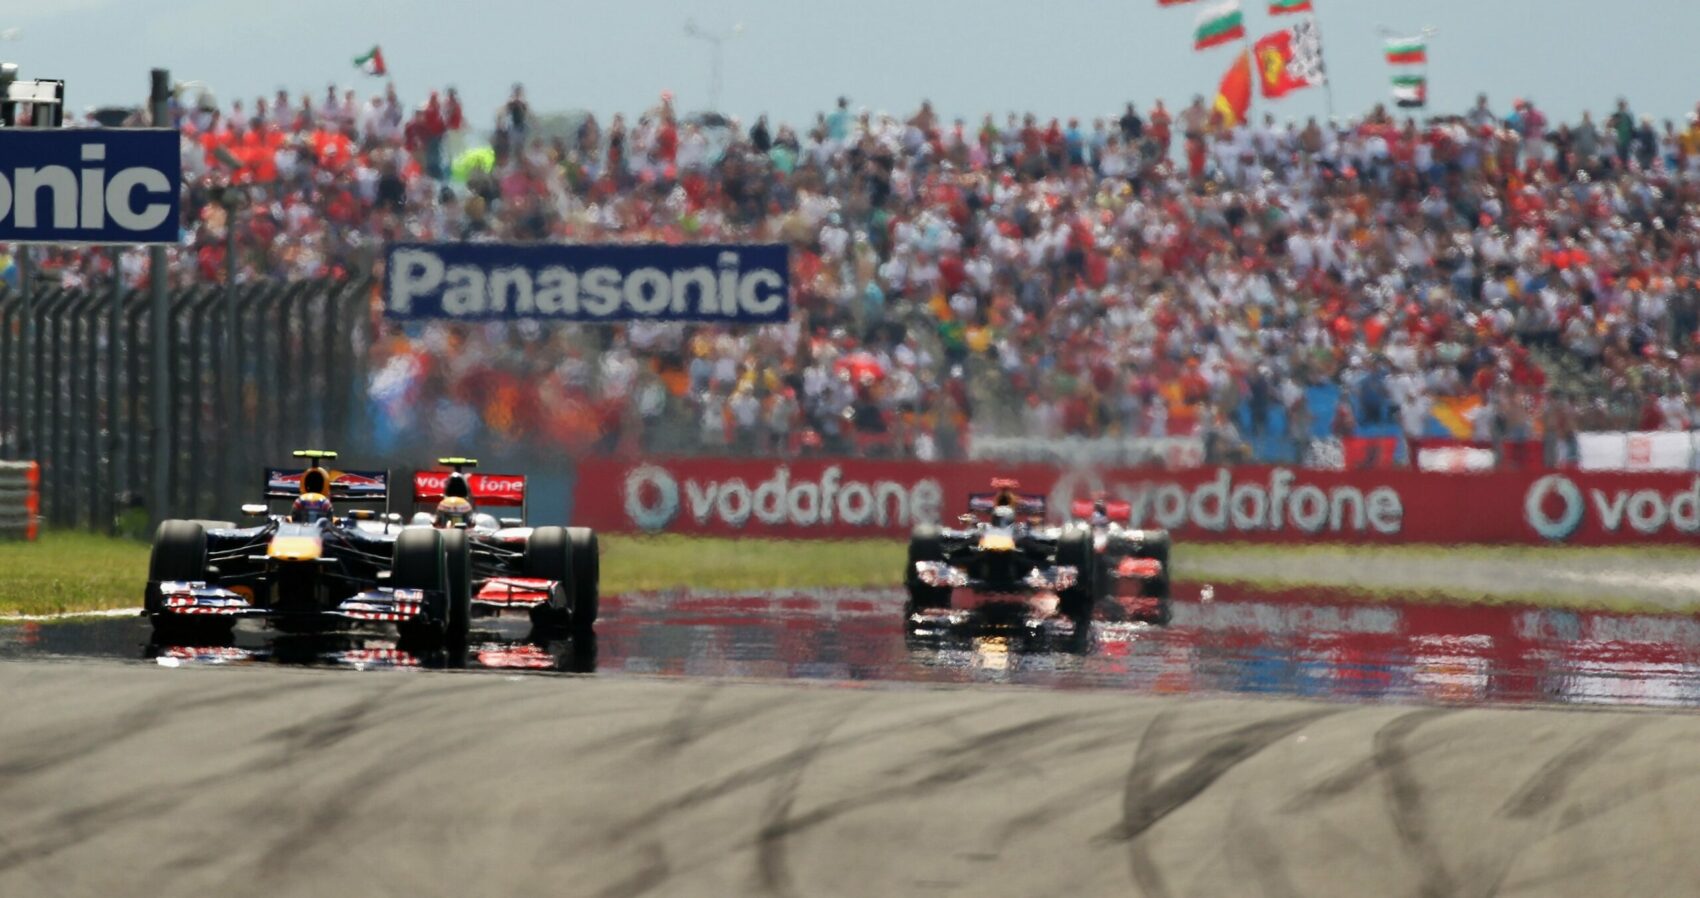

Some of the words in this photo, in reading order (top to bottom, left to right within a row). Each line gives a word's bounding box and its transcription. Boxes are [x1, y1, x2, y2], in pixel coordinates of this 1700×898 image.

[0, 143, 171, 231] nic
[390, 247, 783, 316] Panasonic
[685, 465, 942, 525] vodafone
[1118, 467, 1402, 532] vodafone
